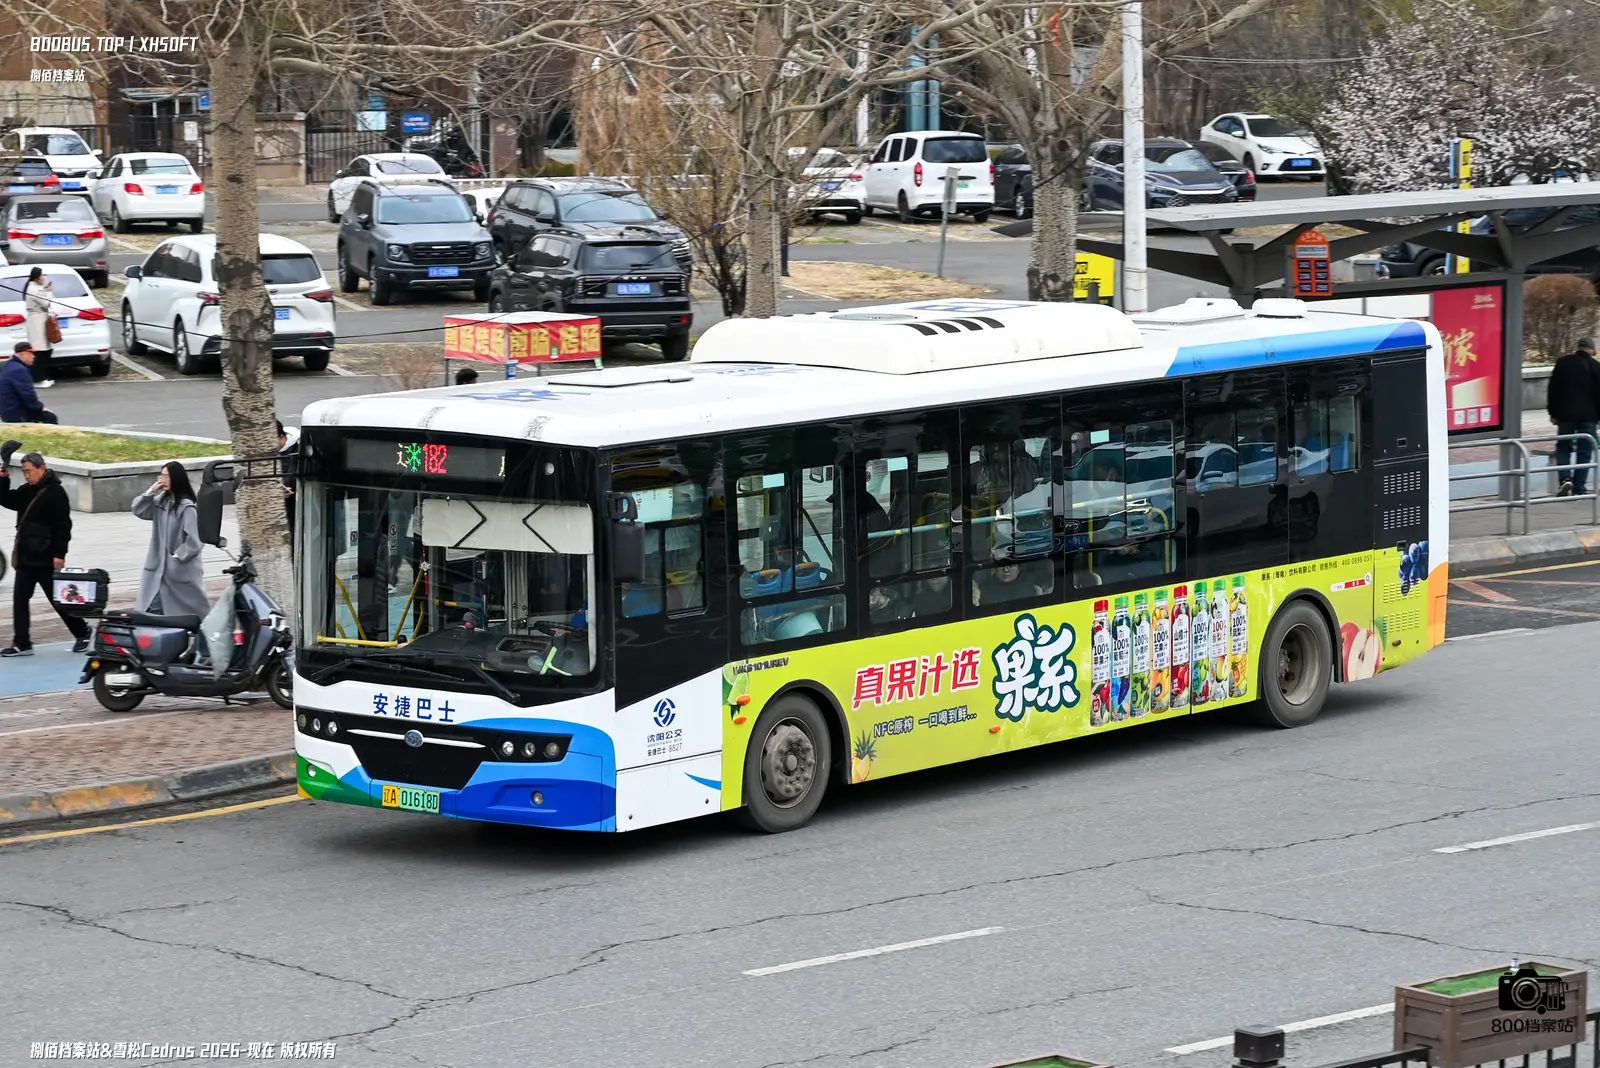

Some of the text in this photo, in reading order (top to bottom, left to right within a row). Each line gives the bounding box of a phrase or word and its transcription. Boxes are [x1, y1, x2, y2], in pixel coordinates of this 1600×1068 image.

[423, 443, 448, 475] 182
[1194, 622, 1207, 635] 100%
[1212, 620, 1227, 633] 100%
[1233, 615, 1246, 628] 100%
[1113, 637, 1129, 651] 100%
[1134, 634, 1148, 647] 100%
[1154, 630, 1169, 644] 100%
[1093, 643, 1109, 656] 100%
[852, 648, 981, 711] 真果汁选
[373, 693, 455, 723] 安捷巴士
[874, 716, 914, 738] NFC原榨
[647, 729, 682, 743] 沈阳公交
